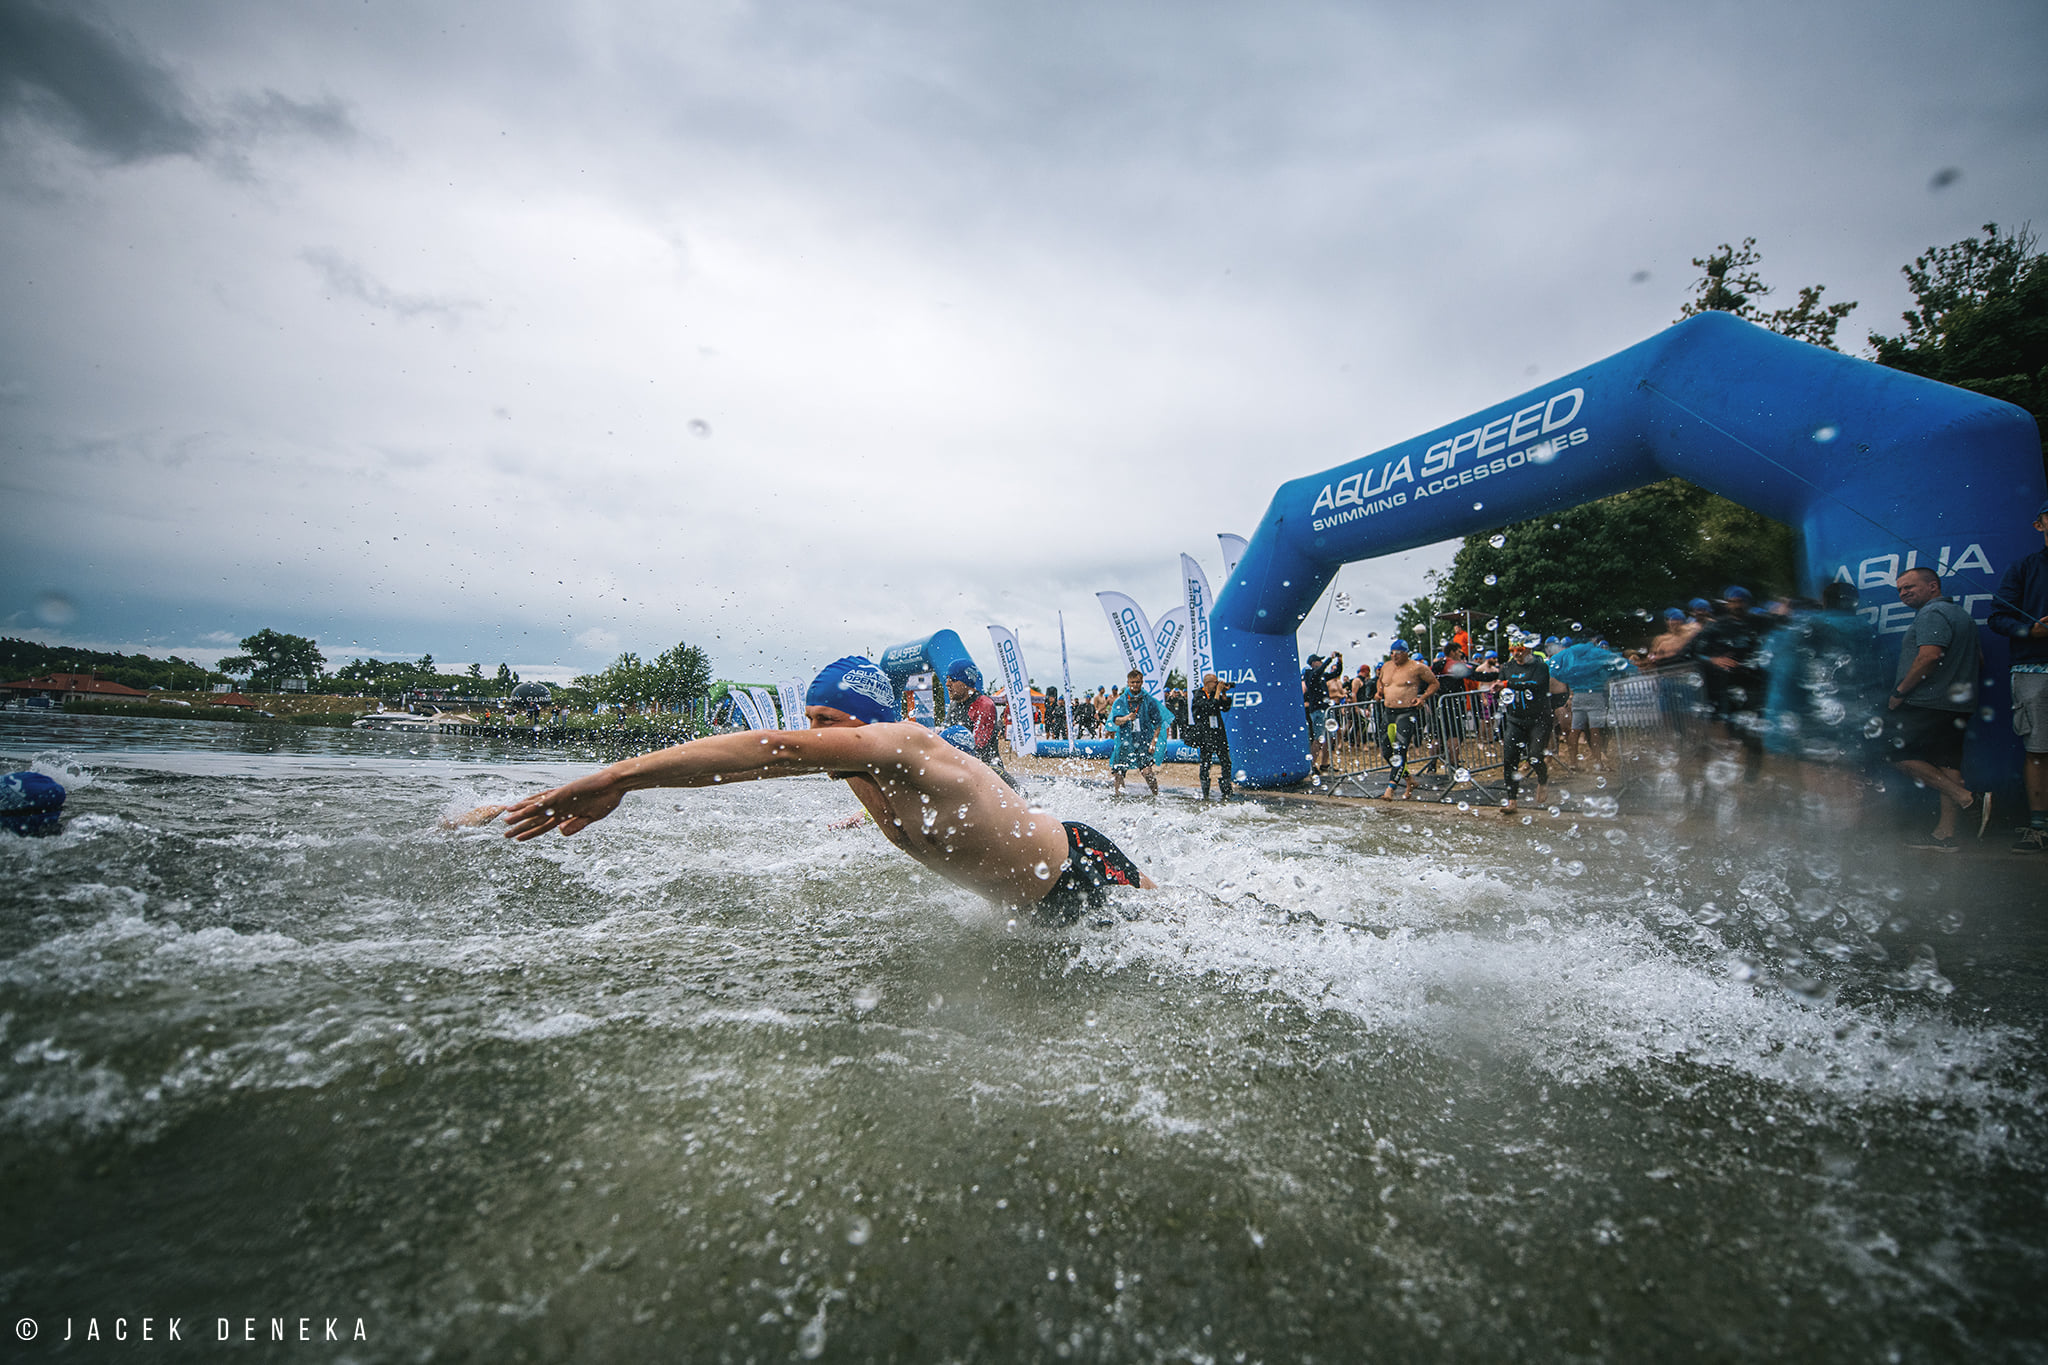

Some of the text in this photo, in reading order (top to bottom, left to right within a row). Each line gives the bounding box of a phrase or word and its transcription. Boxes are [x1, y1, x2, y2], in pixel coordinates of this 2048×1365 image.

[1311, 388, 1585, 516] AQUA SPEED
[1313, 492, 1407, 532] SWIMMING
[1160, 624, 1184, 671] ESSORIES
[844, 674, 875, 687] OPEN
